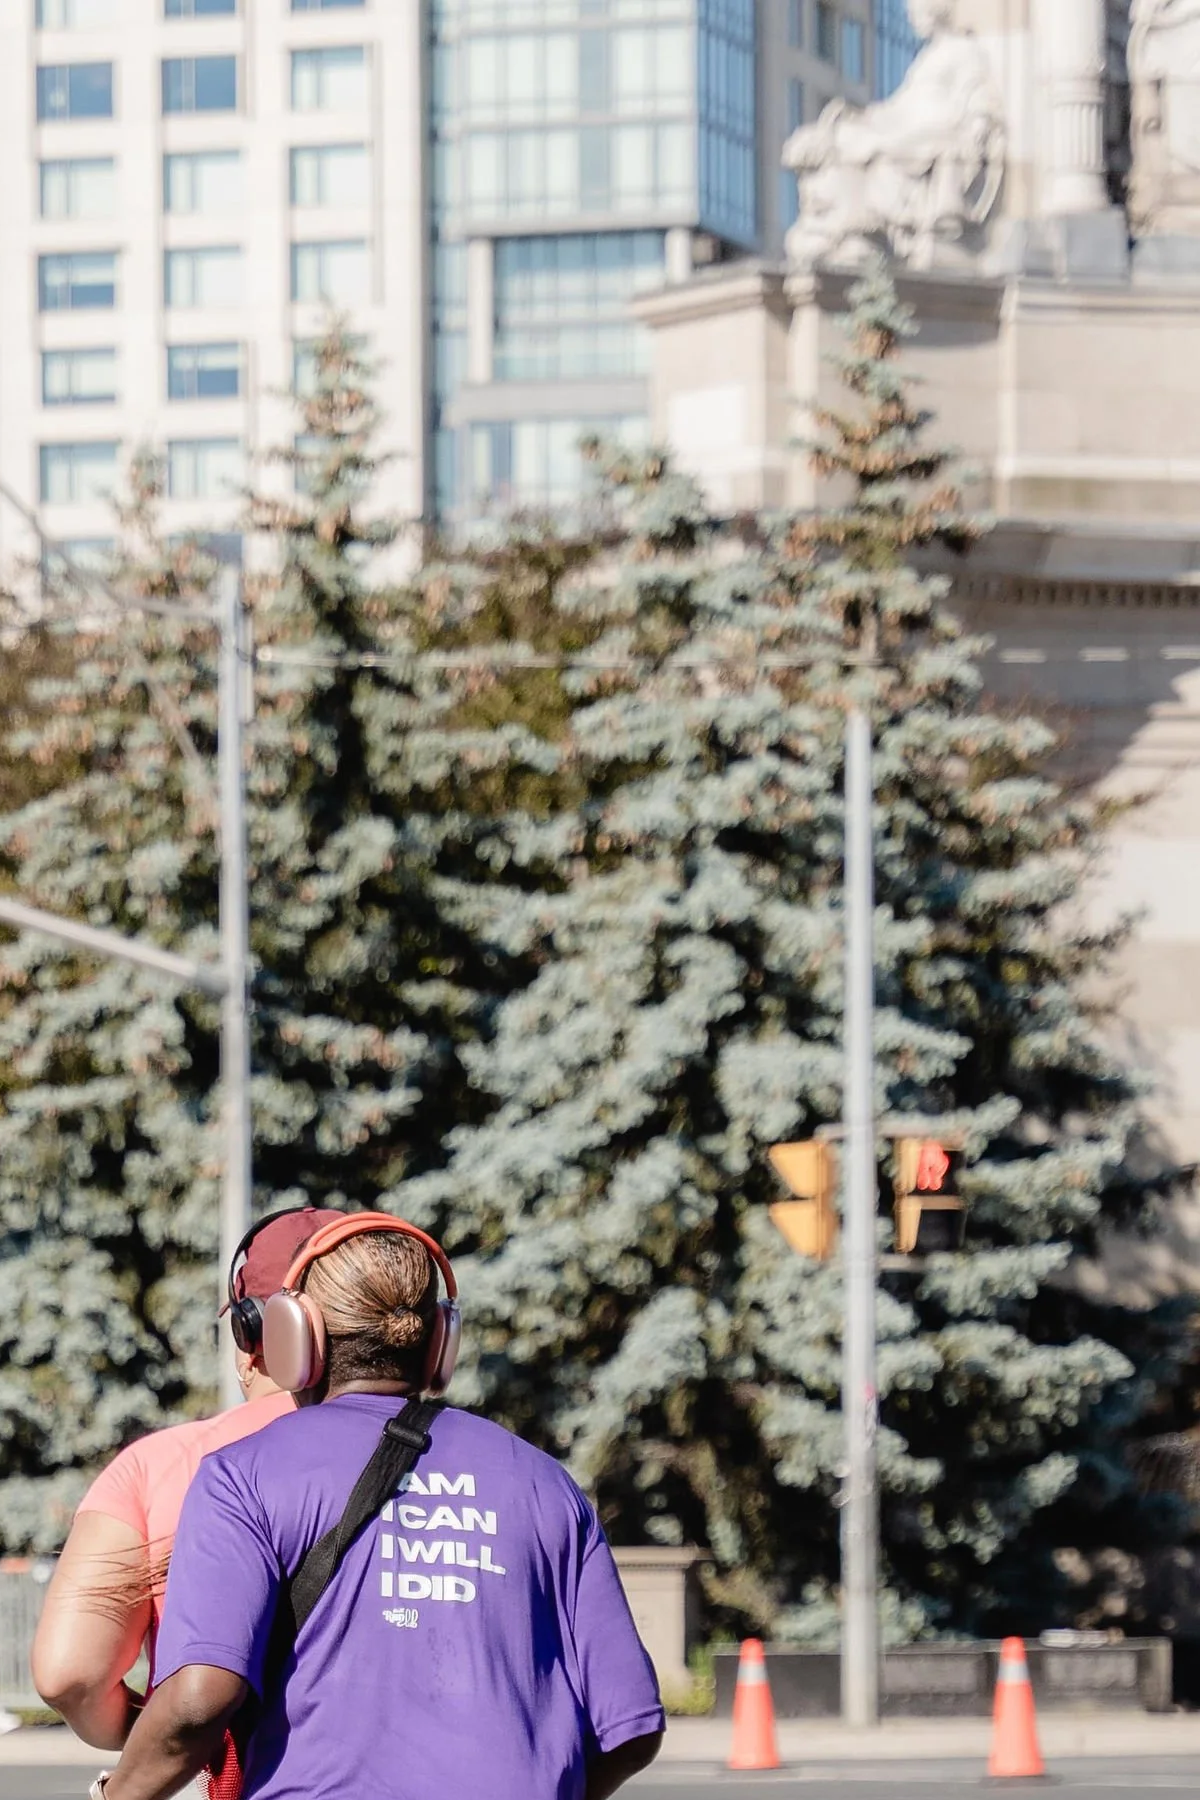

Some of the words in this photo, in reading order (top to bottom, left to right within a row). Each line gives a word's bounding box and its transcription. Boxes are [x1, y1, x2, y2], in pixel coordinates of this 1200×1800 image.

[397, 1472, 476, 1497] AM
[397, 1504, 497, 1535] CAN
[381, 1534, 394, 1559] I
[397, 1537, 506, 1575] WILL
[381, 1572, 394, 1597] I
[398, 1574, 477, 1603] DID
